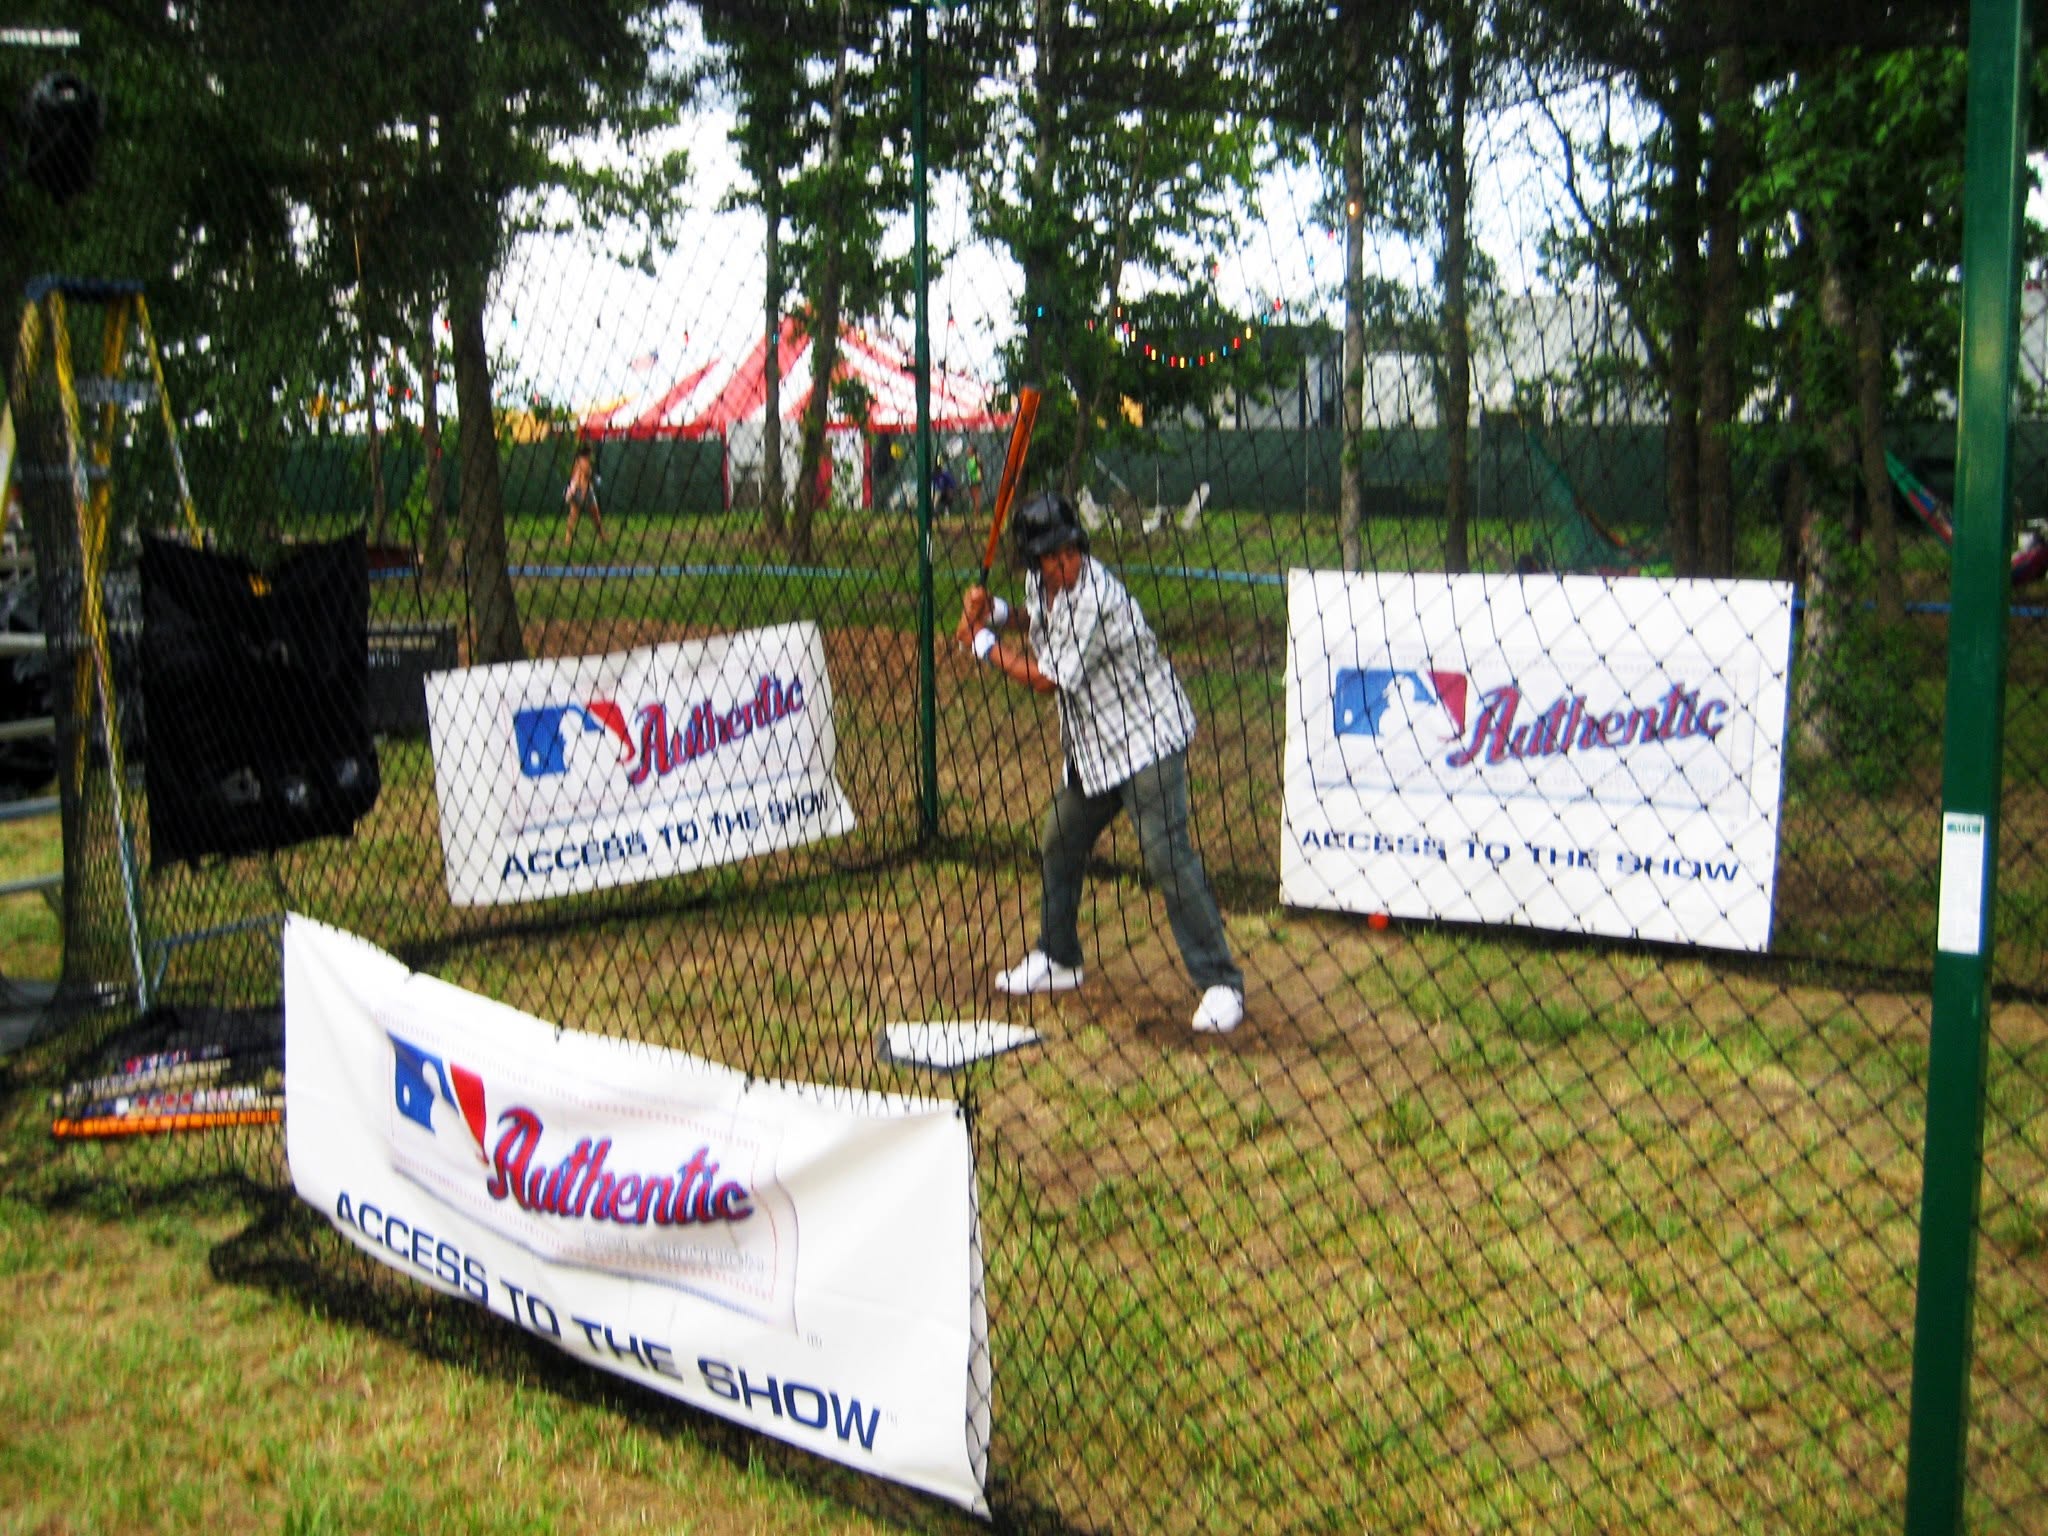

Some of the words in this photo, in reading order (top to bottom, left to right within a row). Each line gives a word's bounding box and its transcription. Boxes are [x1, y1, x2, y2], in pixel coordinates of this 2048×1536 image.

[628, 675, 803, 784] Authentic
[1446, 684, 1729, 767] Authentic
[501, 832, 647, 881] ACCESS
[660, 819, 699, 848] TO
[709, 807, 758, 837] THE
[767, 790, 829, 825] SHOW
[1302, 830, 1446, 860] ACCESS
[1467, 841, 1511, 864] TO
[1528, 843, 1598, 870] THE
[1617, 853, 1738, 881] SHOW
[489, 1106, 754, 1225] Authentic
[336, 1191, 489, 1303] ACCESS
[501, 1281, 561, 1338] TO
[573, 1318, 677, 1377] THE
[699, 1358, 880, 1450] SHOW
